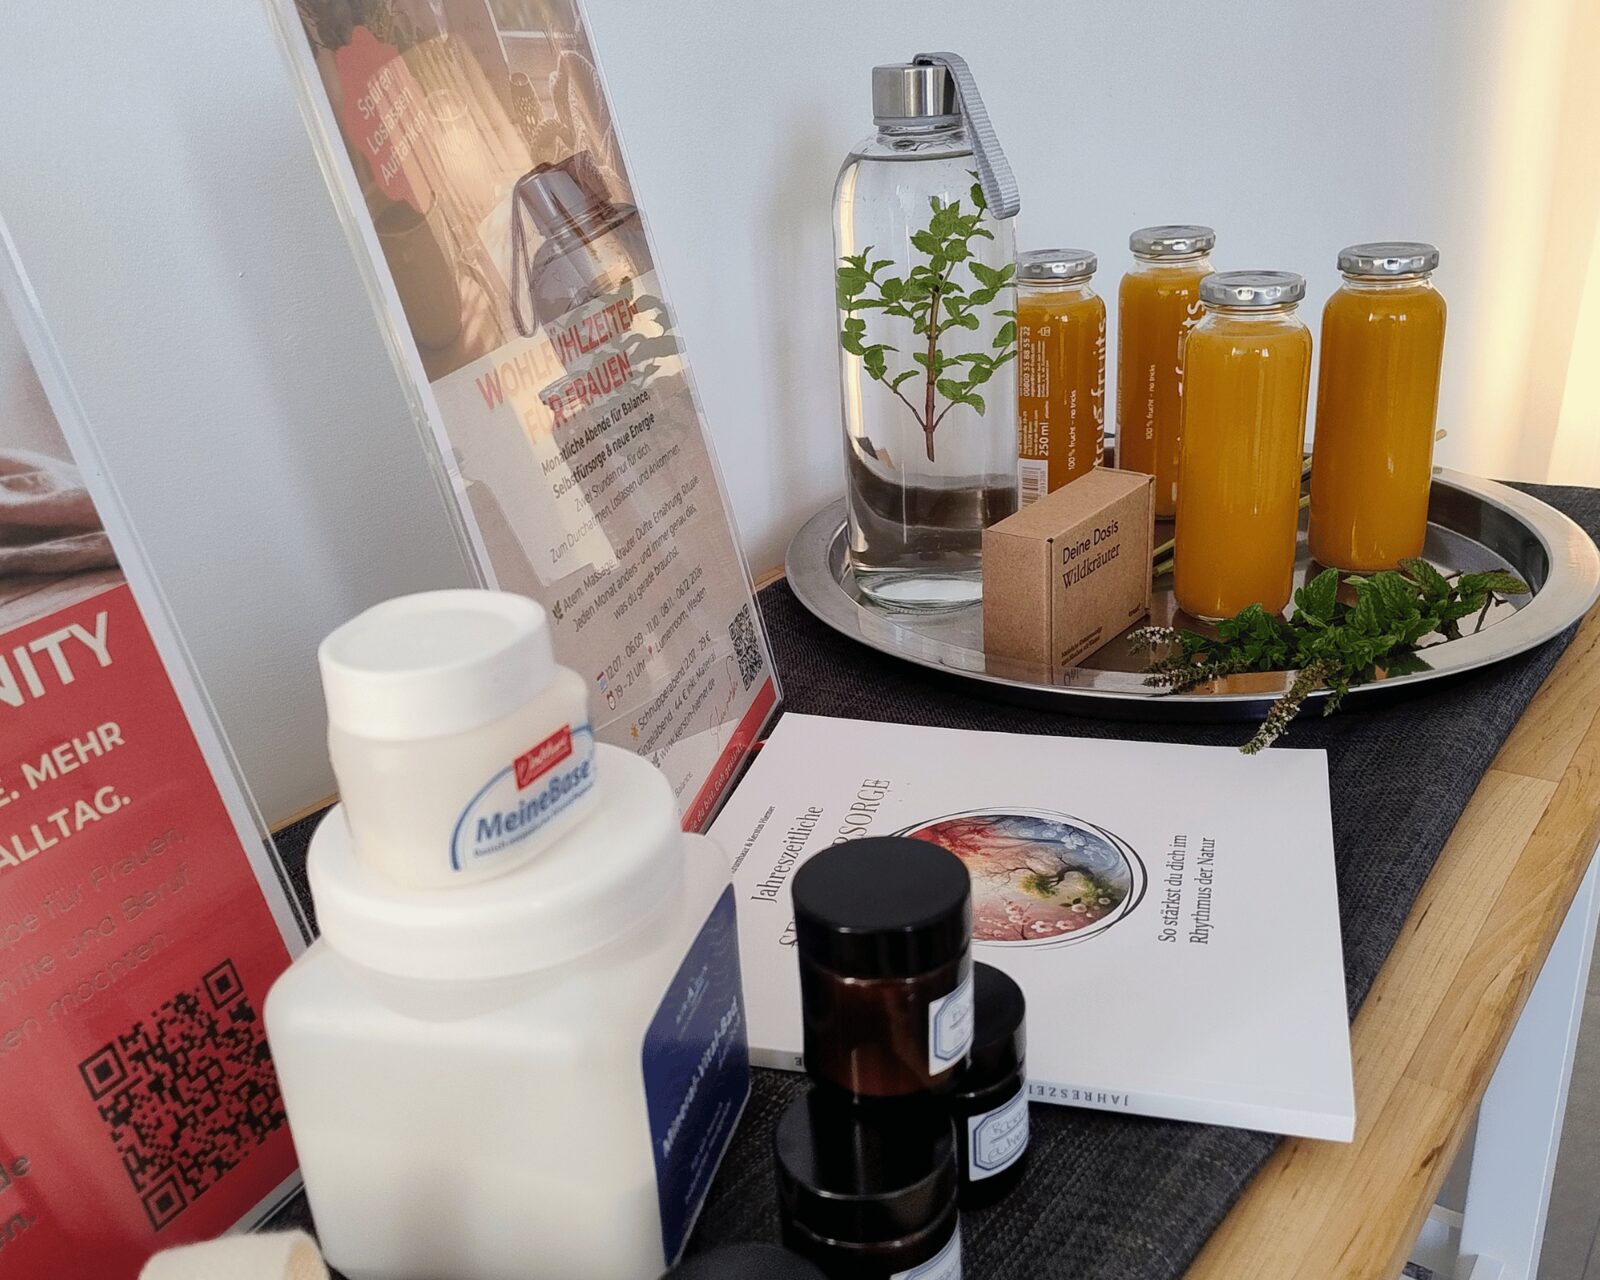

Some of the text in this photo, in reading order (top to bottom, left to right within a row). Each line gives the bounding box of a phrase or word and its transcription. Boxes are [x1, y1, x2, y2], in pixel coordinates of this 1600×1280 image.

[366, 87, 414, 155] Loslassen
[1069, 389, 1077, 408] tricks
[1146, 399, 1154, 419] frucht
[540, 434, 586, 476] Monatliche
[584, 416, 612, 448] Abende
[1039, 422, 1049, 436] ml
[1039, 437, 1049, 456] 250
[1068, 426, 1077, 447] frucht
[1145, 427, 1153, 440] 100
[552, 450, 607, 499] Selbstfürsorge
[612, 432, 630, 452] neue
[629, 412, 656, 440] Energie
[1068, 456, 1076, 470] 100
[590, 469, 617, 498] Stunden
[550, 540, 569, 564] Zum
[1062, 519, 1119, 565] Deine Dosis
[1062, 544, 1121, 590] Wildkräuter
[571, 604, 596, 633] Jeden
[593, 582, 619, 612] Monat
[20, 721, 126, 791] MEHR
[750, 805, 824, 904] Jahreszeitliche
[1158, 834, 1188, 943] So stärkst du dich im
[1188, 837, 1216, 945] Rhythmus der Natur
